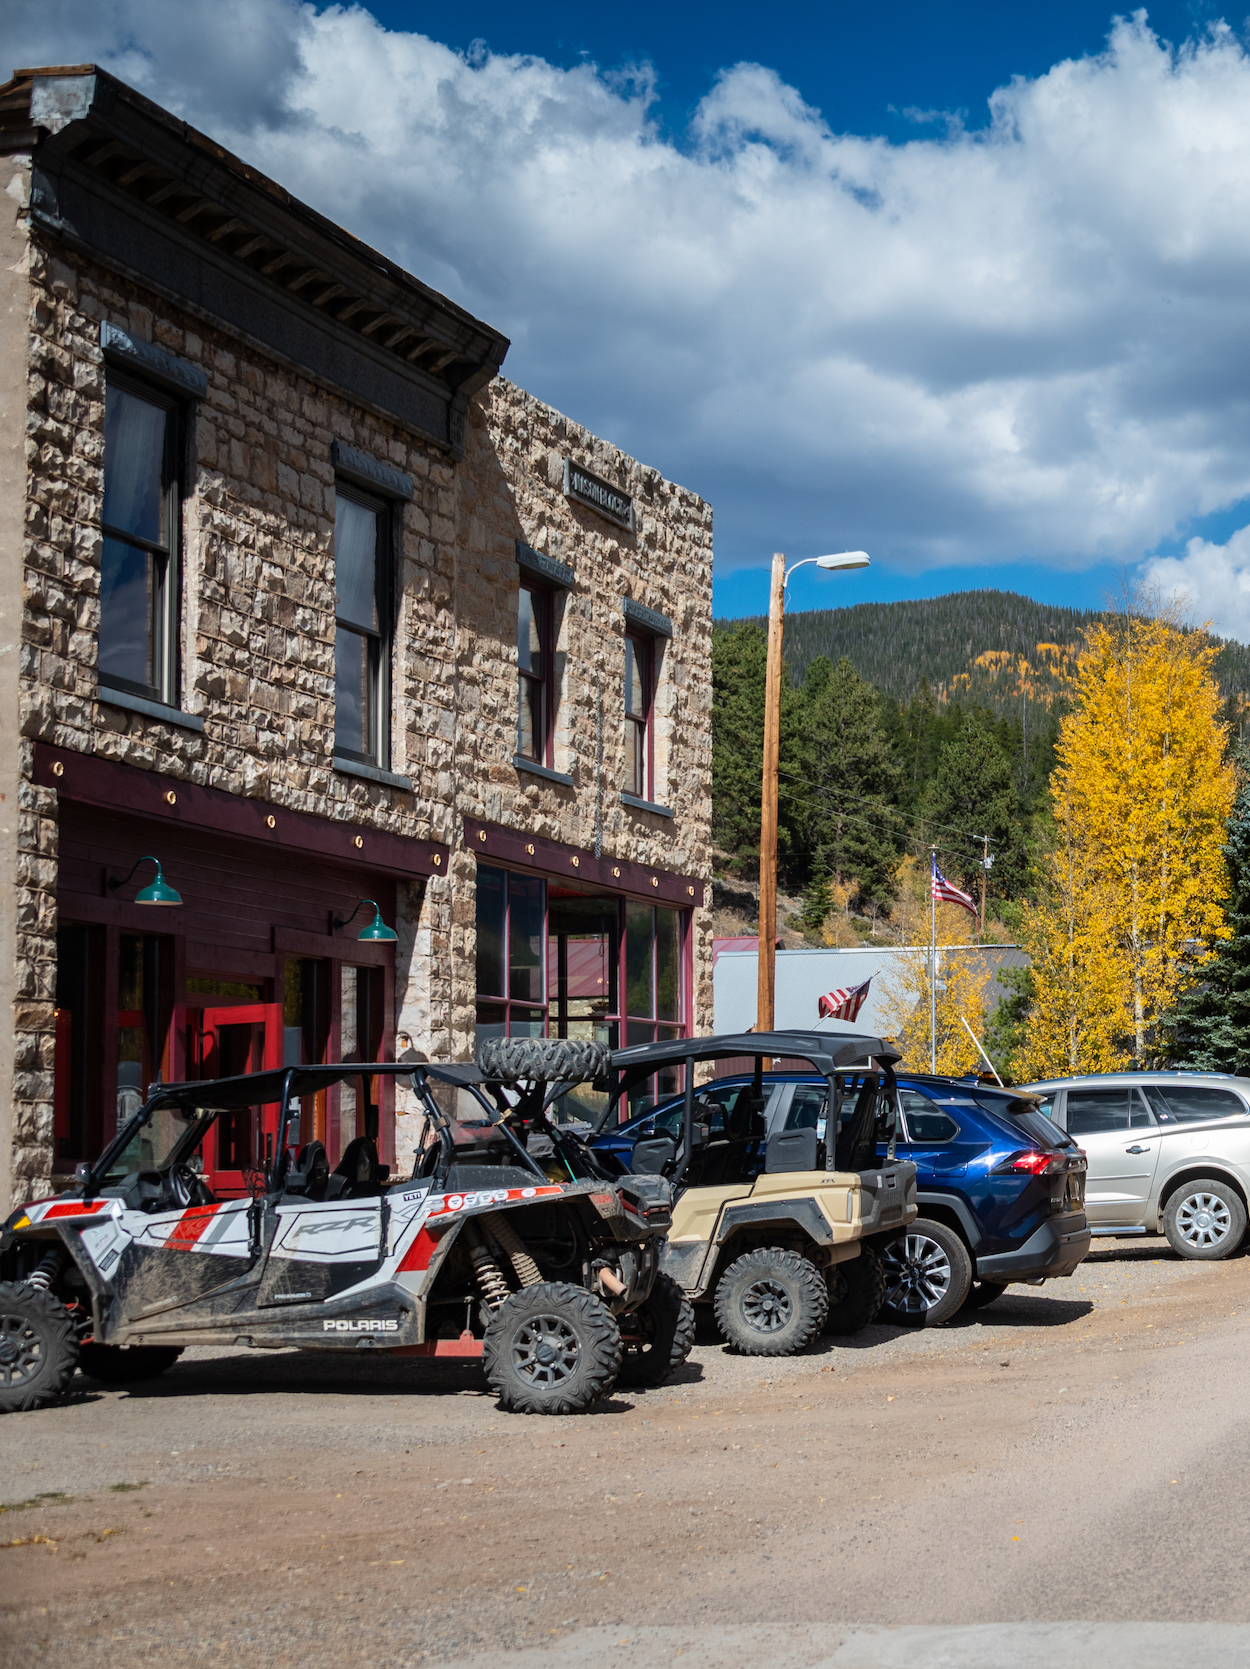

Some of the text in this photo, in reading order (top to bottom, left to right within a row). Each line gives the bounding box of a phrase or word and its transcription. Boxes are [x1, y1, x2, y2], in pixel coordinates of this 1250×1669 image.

[404, 1191, 420, 1200] YETI
[292, 1216, 377, 1239] RZR
[323, 1320, 398, 1331] POLARIS
